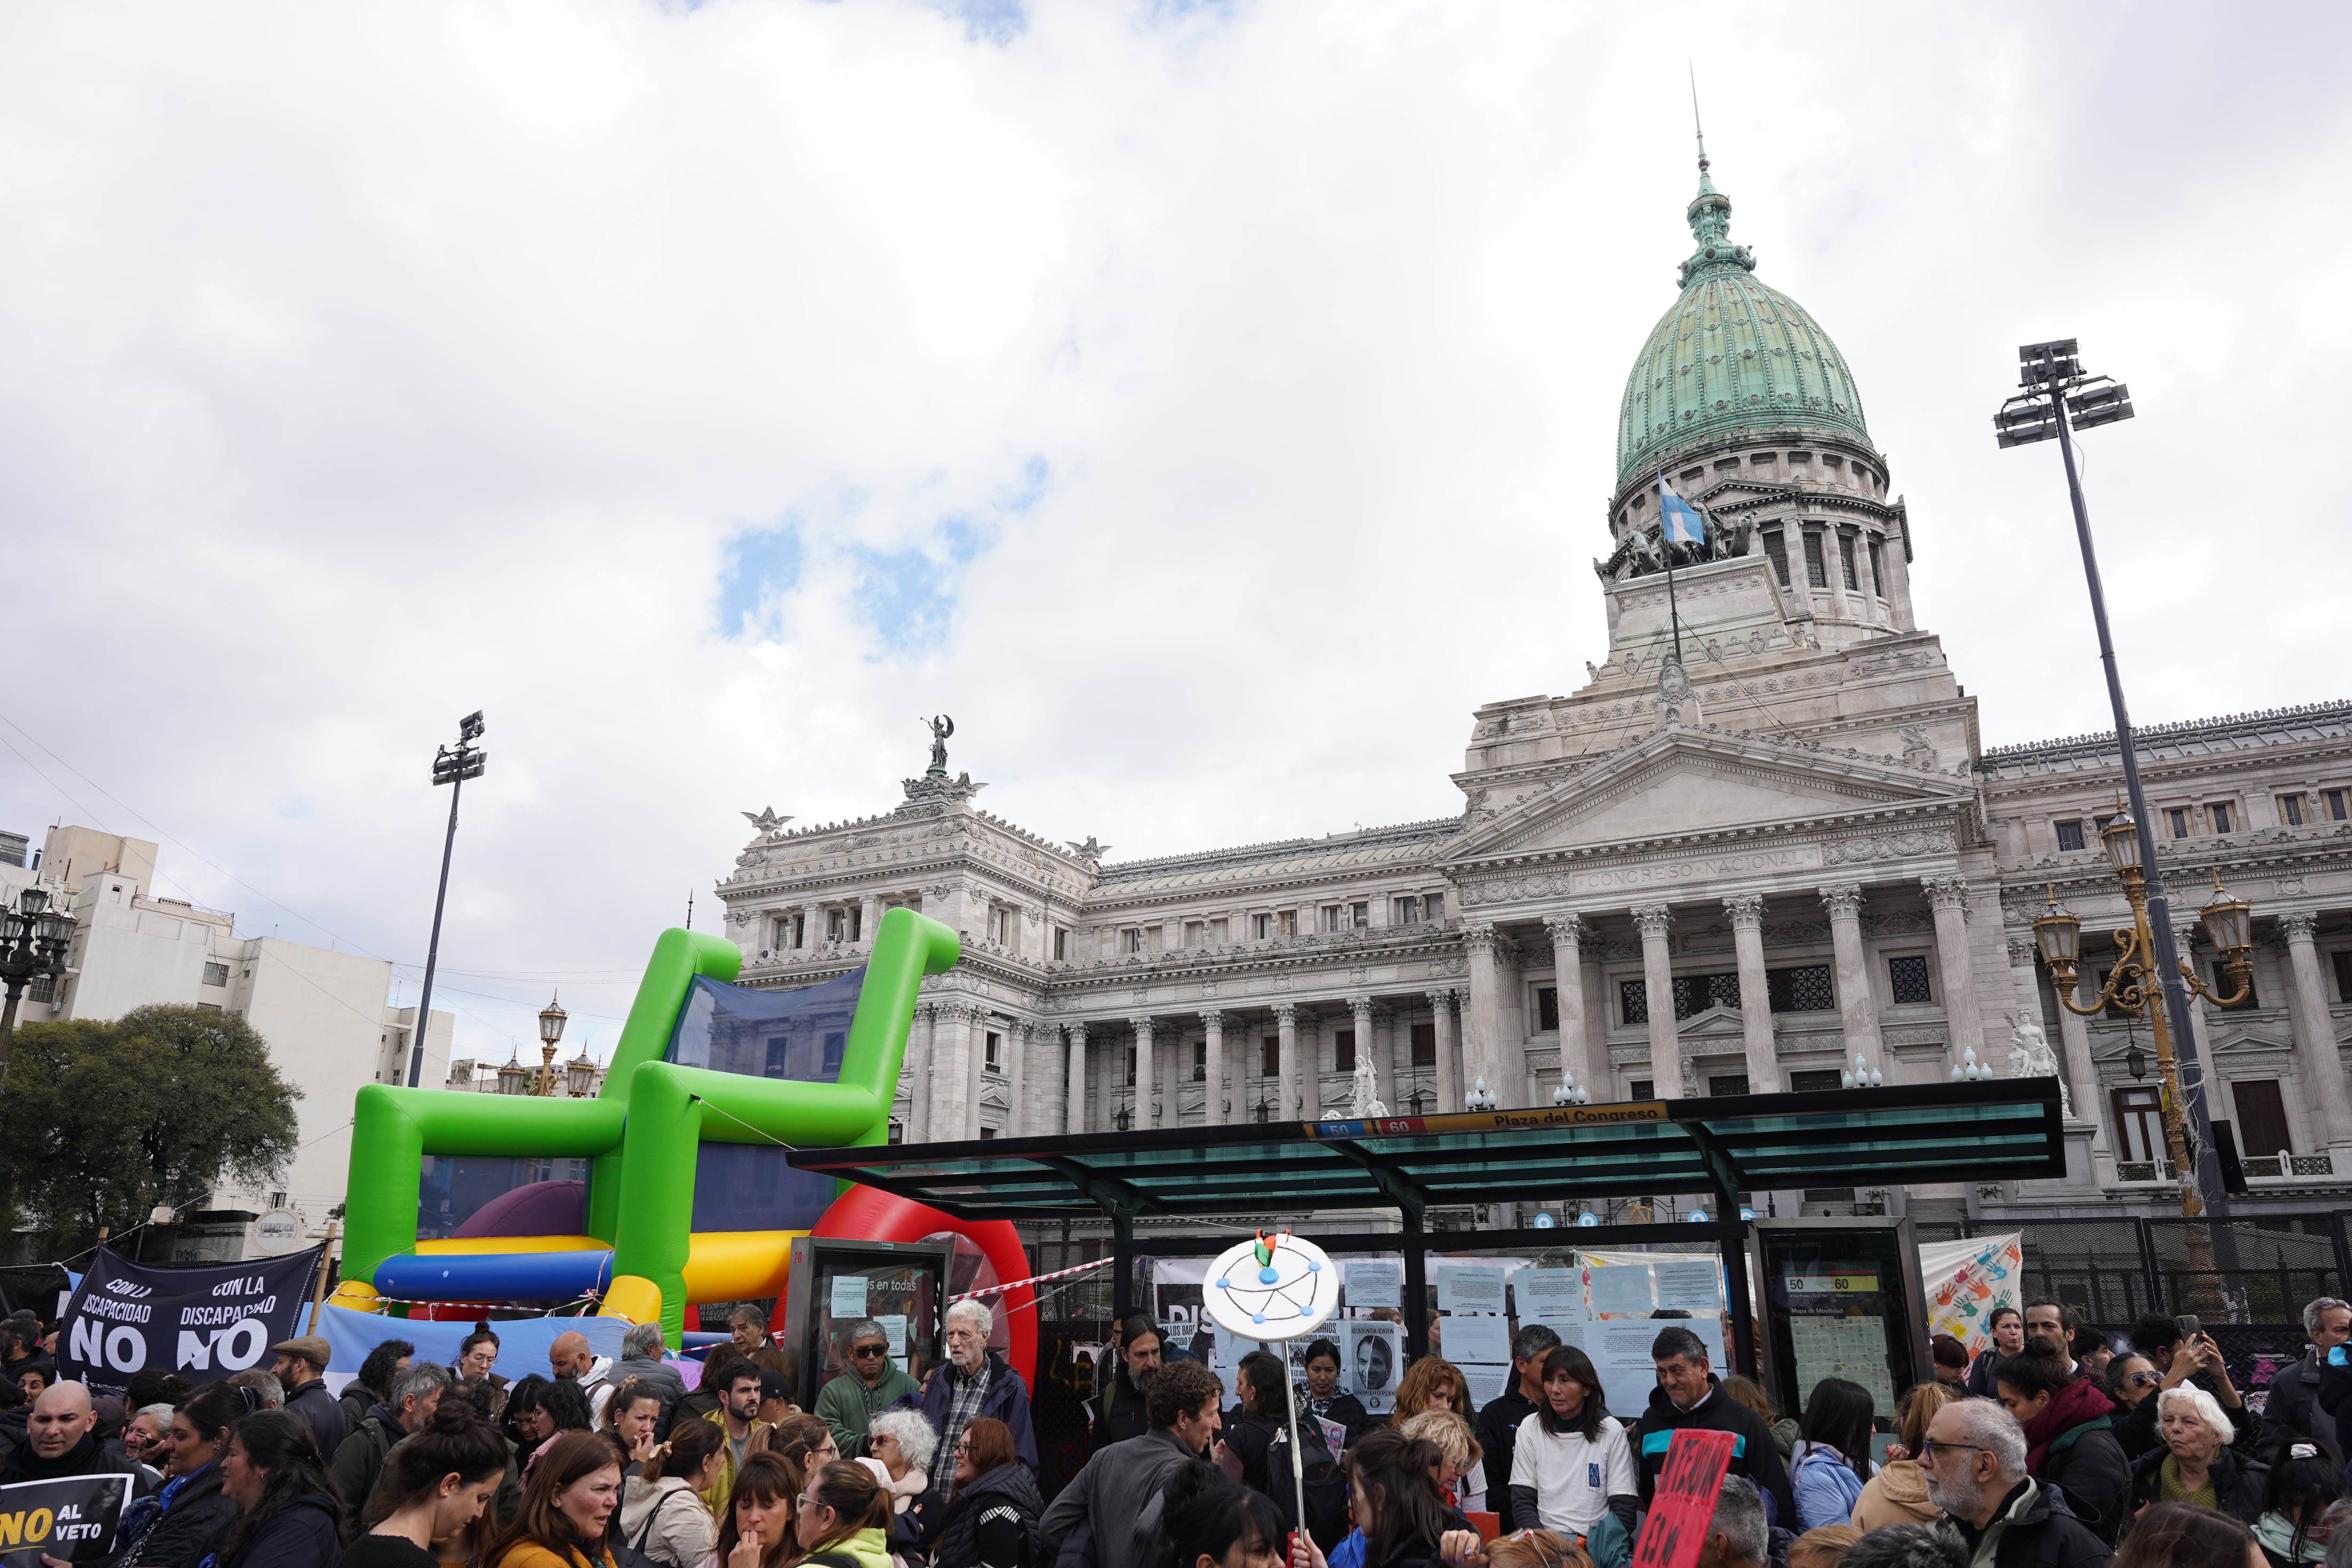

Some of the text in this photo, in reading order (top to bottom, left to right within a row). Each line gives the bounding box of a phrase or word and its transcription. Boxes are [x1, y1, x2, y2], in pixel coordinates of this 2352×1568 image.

[1588, 852, 1804, 887] CONGRESO NACIONAL
[1389, 1121, 1409, 1133] 60
[1494, 1109, 1658, 1127] Plaza del Congreso
[1329, 1125, 1350, 1136] 50
[106, 1279, 152, 1298] CON LA
[212, 1276, 264, 1296] CON LA
[877, 1281, 888, 1290] en
[891, 1279, 916, 1291] todas
[1790, 1279, 1804, 1289] 50
[1835, 1279, 1849, 1289] 60
[82, 1293, 151, 1323] ISCAPACIDAD
[180, 1295, 277, 1325] DISCAPACAD
[1170, 1325, 1180, 1336] LOS
[70, 1315, 146, 1373] NO
[177, 1318, 268, 1371] NO
[57, 1504, 82, 1520] AL
[0, 1507, 53, 1546] NO
[56, 1523, 102, 1541] VETO
